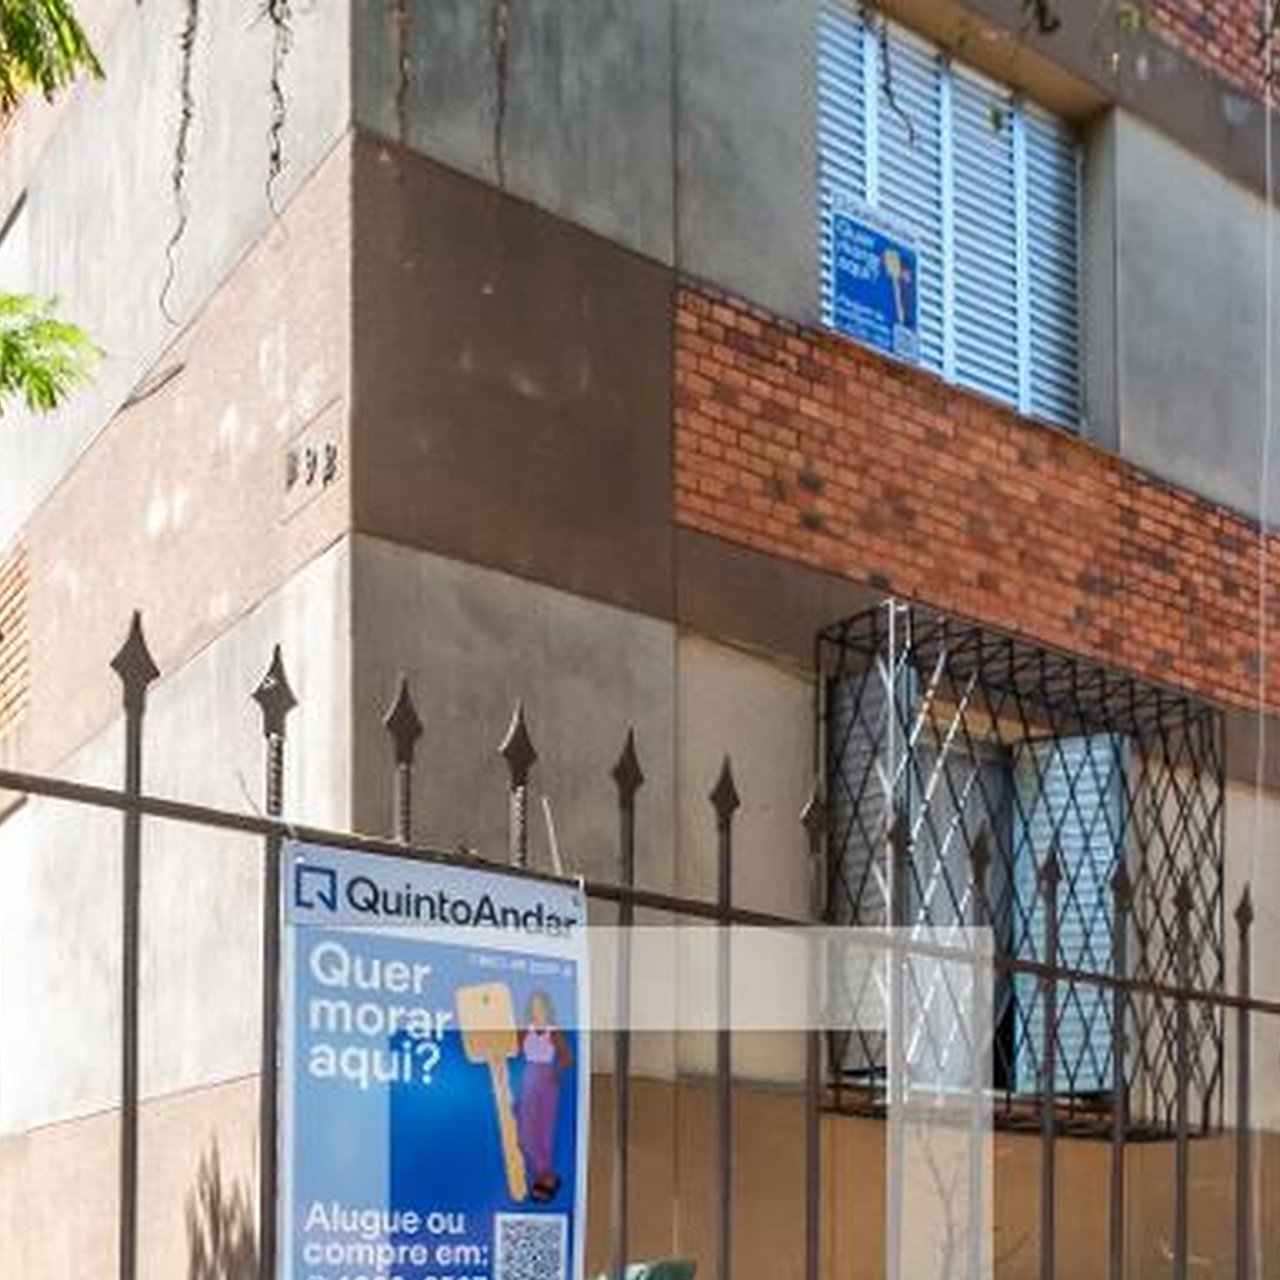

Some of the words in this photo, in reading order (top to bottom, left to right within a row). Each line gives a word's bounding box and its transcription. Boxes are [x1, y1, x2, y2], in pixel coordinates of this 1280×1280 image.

[345, 875, 577, 937] QuintoAndar
[309, 941, 432, 994] Quer
[309, 998, 453, 1040] morar
[309, 1041, 441, 1090] aqui?
[304, 1201, 420, 1239] Alugue
[427, 1211, 466, 1234] ou
[303, 1242, 428, 1271] compre
[435, 1244, 489, 1267] em:
